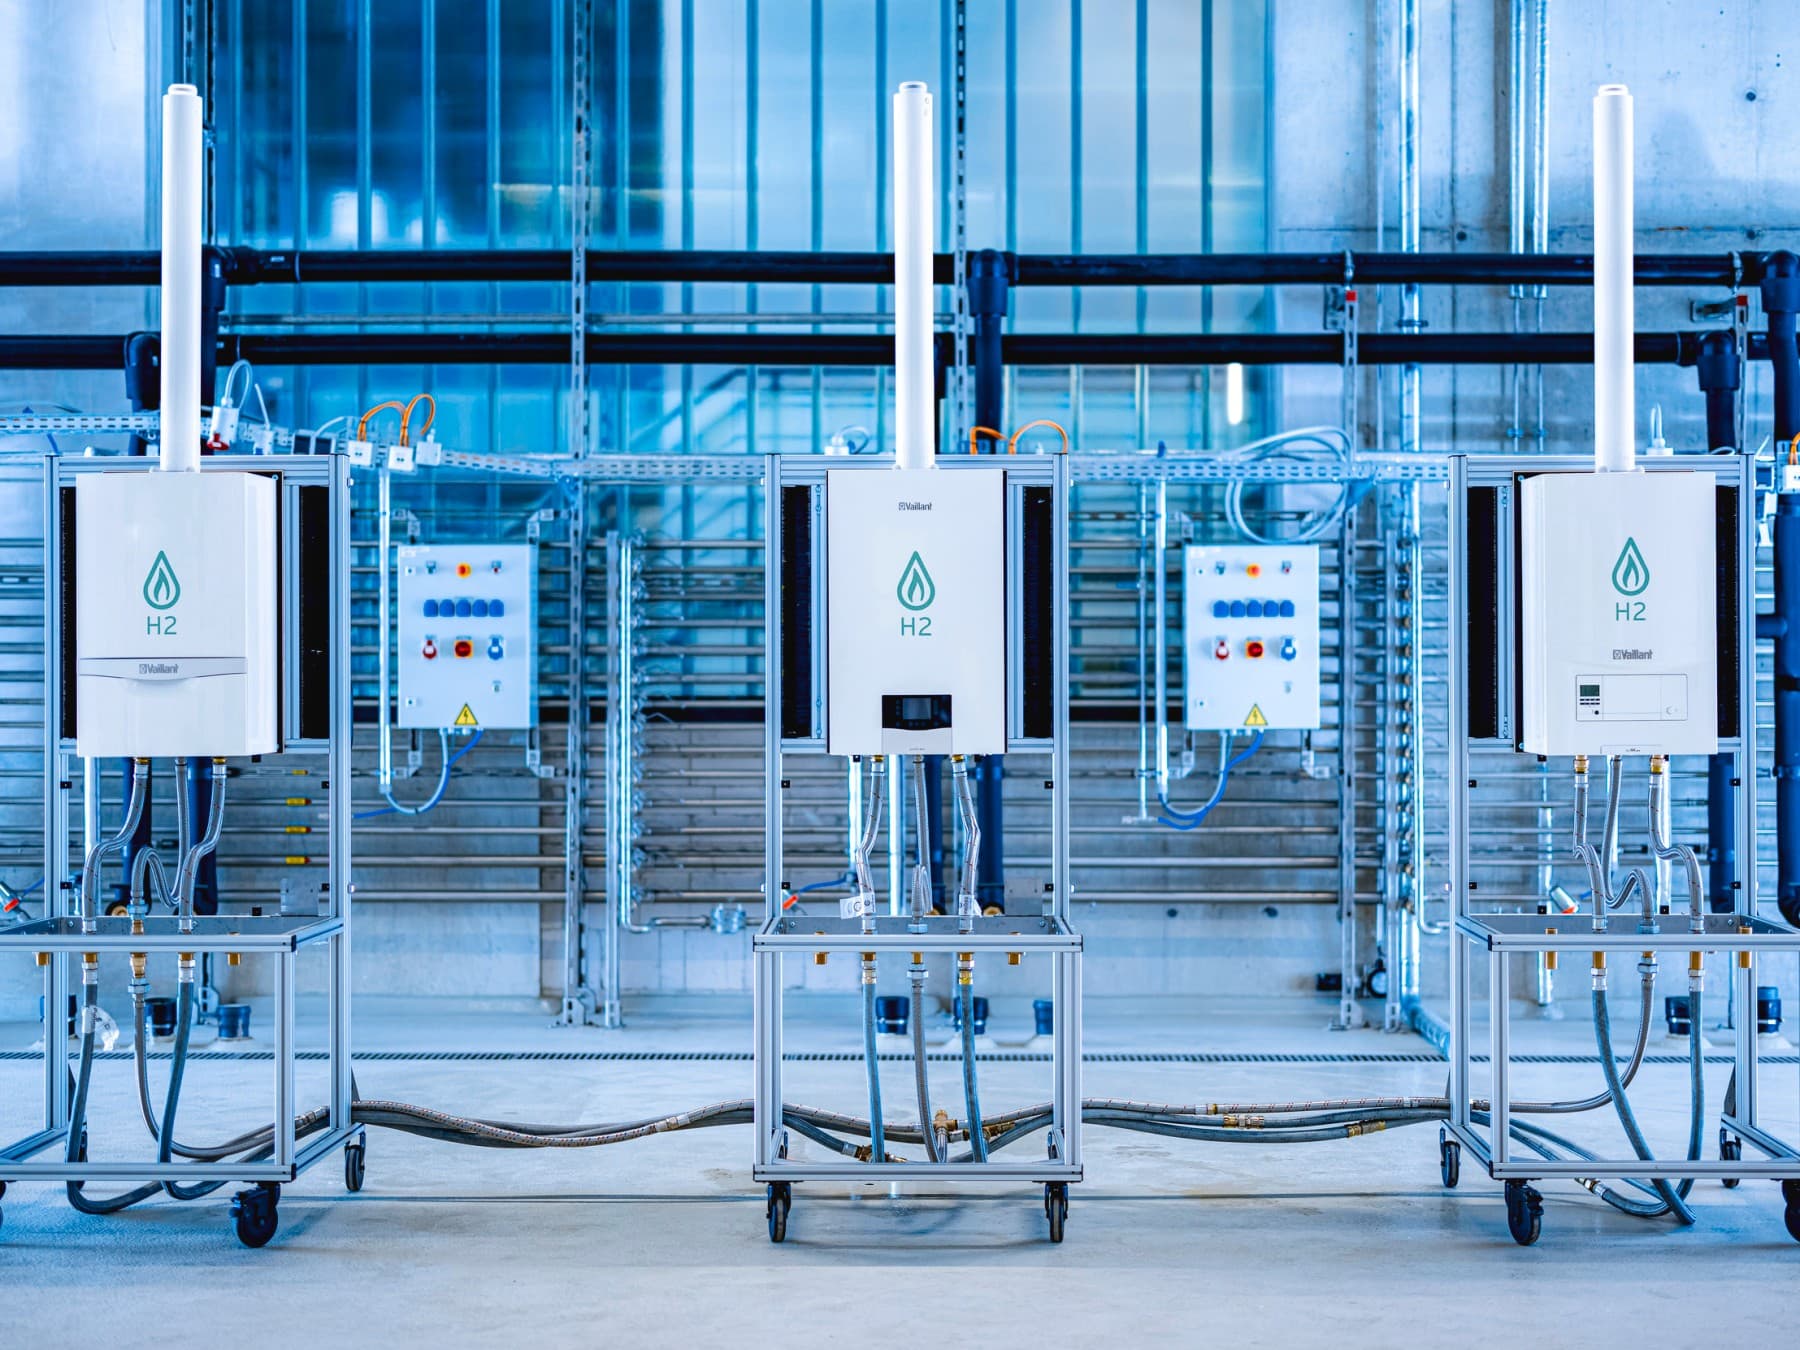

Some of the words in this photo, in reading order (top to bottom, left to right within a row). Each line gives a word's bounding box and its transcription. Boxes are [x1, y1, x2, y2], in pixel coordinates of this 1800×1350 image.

[906, 501, 932, 511] Vaillant
[1616, 602, 1646, 621] H2
[147, 616, 177, 635] H2
[901, 617, 932, 636] H2
[1621, 649, 1653, 660] Vaillant
[147, 663, 179, 674] Vaillant
